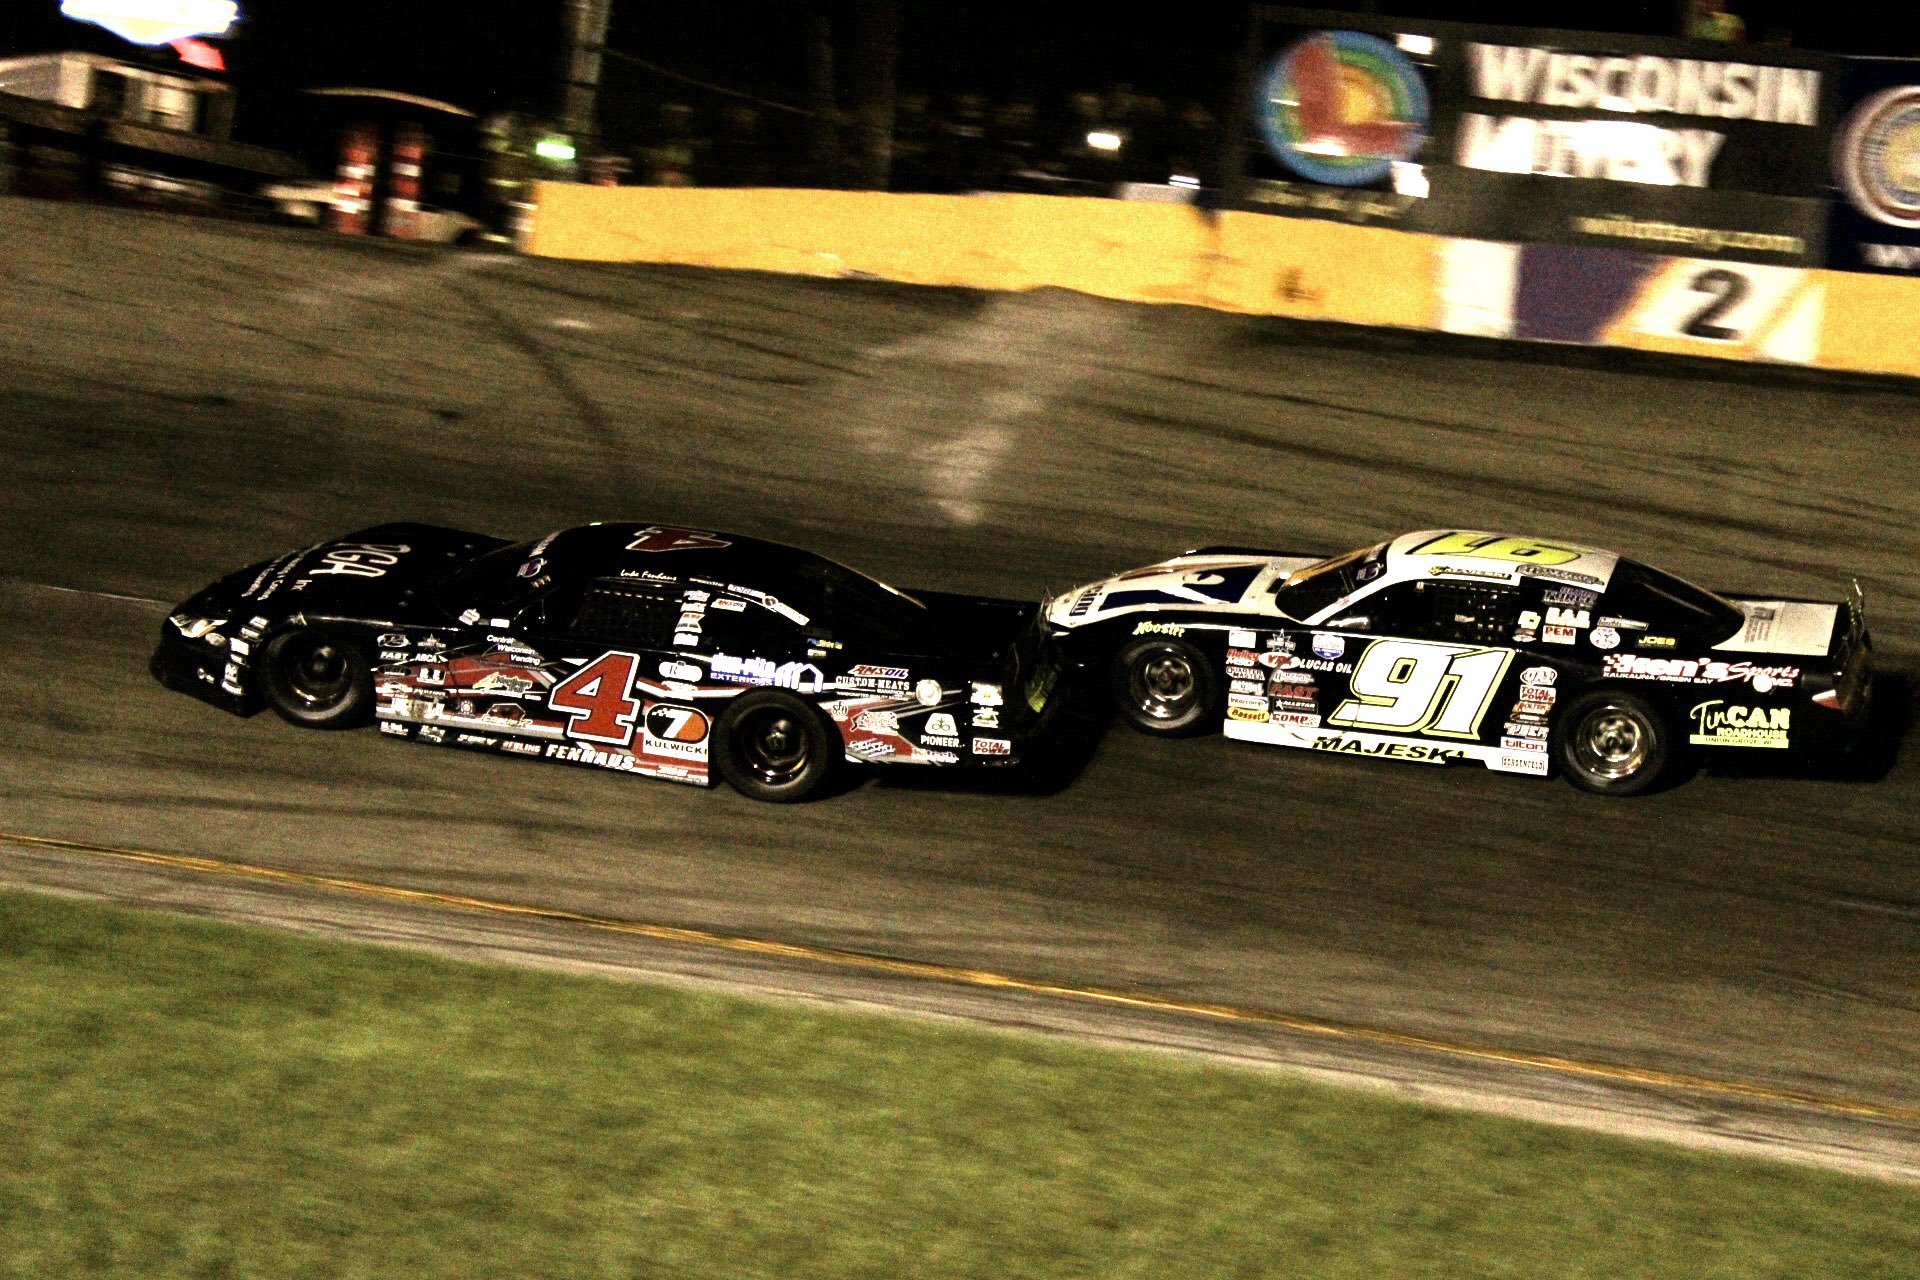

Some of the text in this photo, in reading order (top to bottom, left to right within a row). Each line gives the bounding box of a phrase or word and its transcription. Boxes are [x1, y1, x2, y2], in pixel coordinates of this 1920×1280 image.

[1466, 42, 1821, 126] WISCONSIN
[1680, 268, 1751, 340] 2
[1545, 627, 1574, 636] PEM
[486, 634, 515, 644] Central
[1638, 635, 1676, 647] JOES
[497, 644, 536, 655] Wisconsin
[853, 664, 908, 678] AMSOIL
[1300, 658, 1352, 674] LUCAS OIL
[1718, 661, 1800, 682] Sports
[1269, 683, 1319, 699] FAST
[1327, 638, 1516, 740] 91
[1521, 686, 1550, 695] TOTAL
[548, 650, 641, 746] 4
[1232, 709, 1265, 720] Bassett
[1717, 727, 1788, 740] ROADHOUSE
[645, 738, 708, 755] KULWICKI
[921, 735, 960, 748] PIONEER
[974, 740, 1004, 748] TOTAL
[1504, 740, 1544, 751] tilton
[545, 744, 637, 770] FENHAUS
